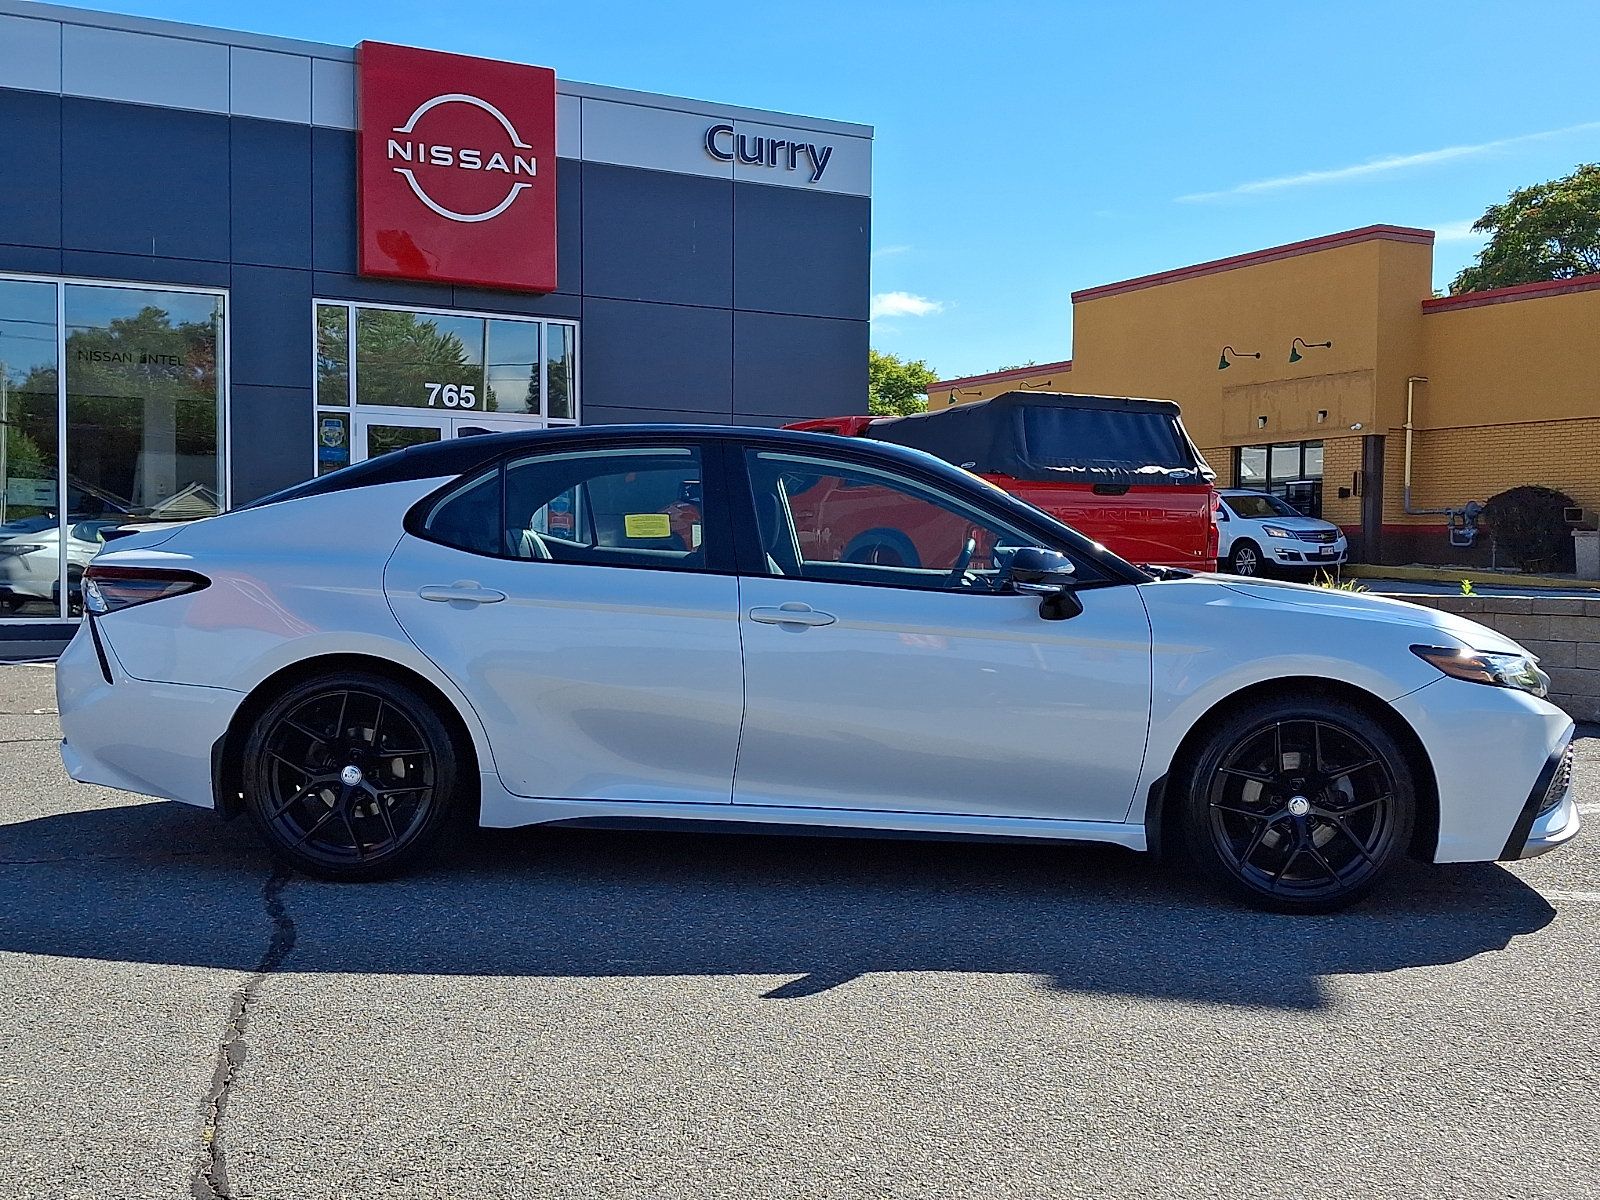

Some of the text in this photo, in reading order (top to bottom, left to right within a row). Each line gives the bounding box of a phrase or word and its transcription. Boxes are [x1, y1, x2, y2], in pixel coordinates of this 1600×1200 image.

[387, 139, 537, 176] NISSAN
[705, 124, 833, 182] Curry
[77, 350, 132, 363] NISSAN
[424, 382, 476, 408] 765
